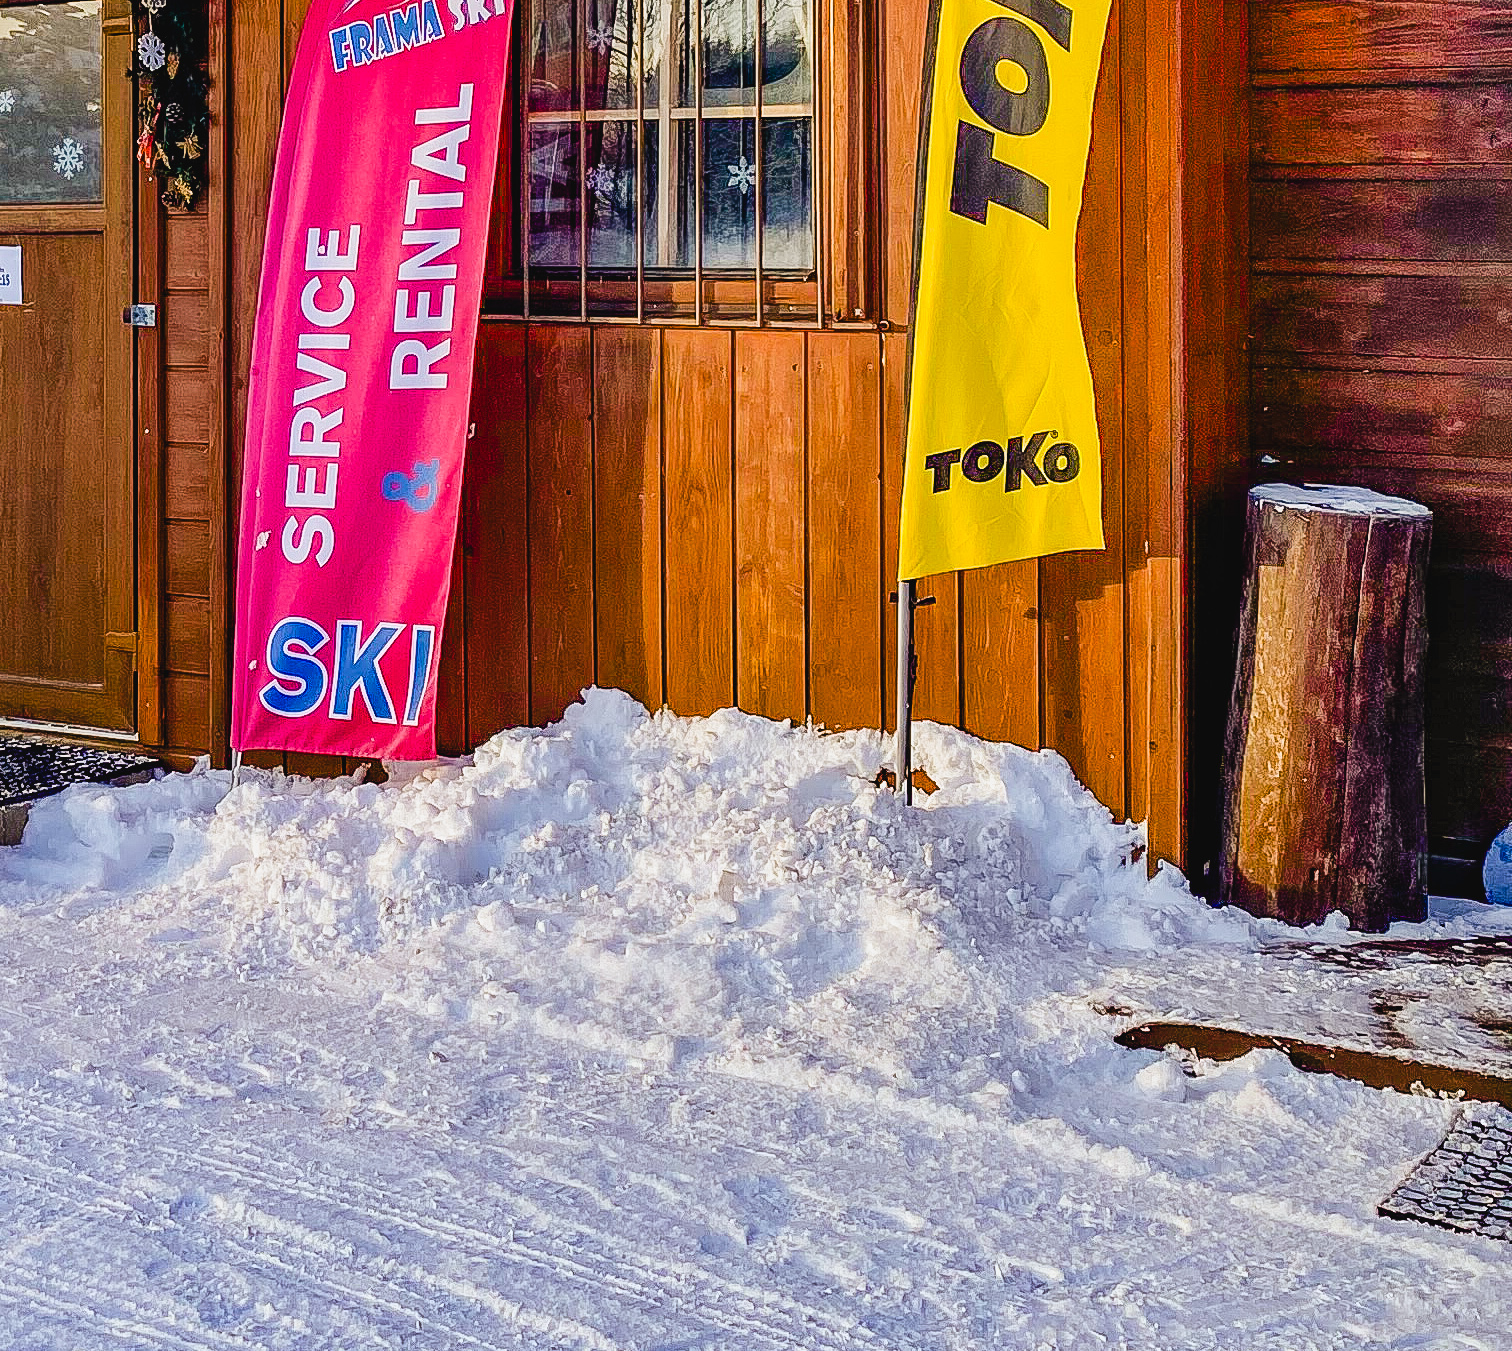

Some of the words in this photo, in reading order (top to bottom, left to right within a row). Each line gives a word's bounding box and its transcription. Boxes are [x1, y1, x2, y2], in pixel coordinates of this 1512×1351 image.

[389, 83, 474, 390] RENTAL
[281, 224, 361, 568] SERVICE
[381, 458, 440, 513] &
[925, 430, 1081, 494] TOKO
[259, 616, 436, 726] SKI
